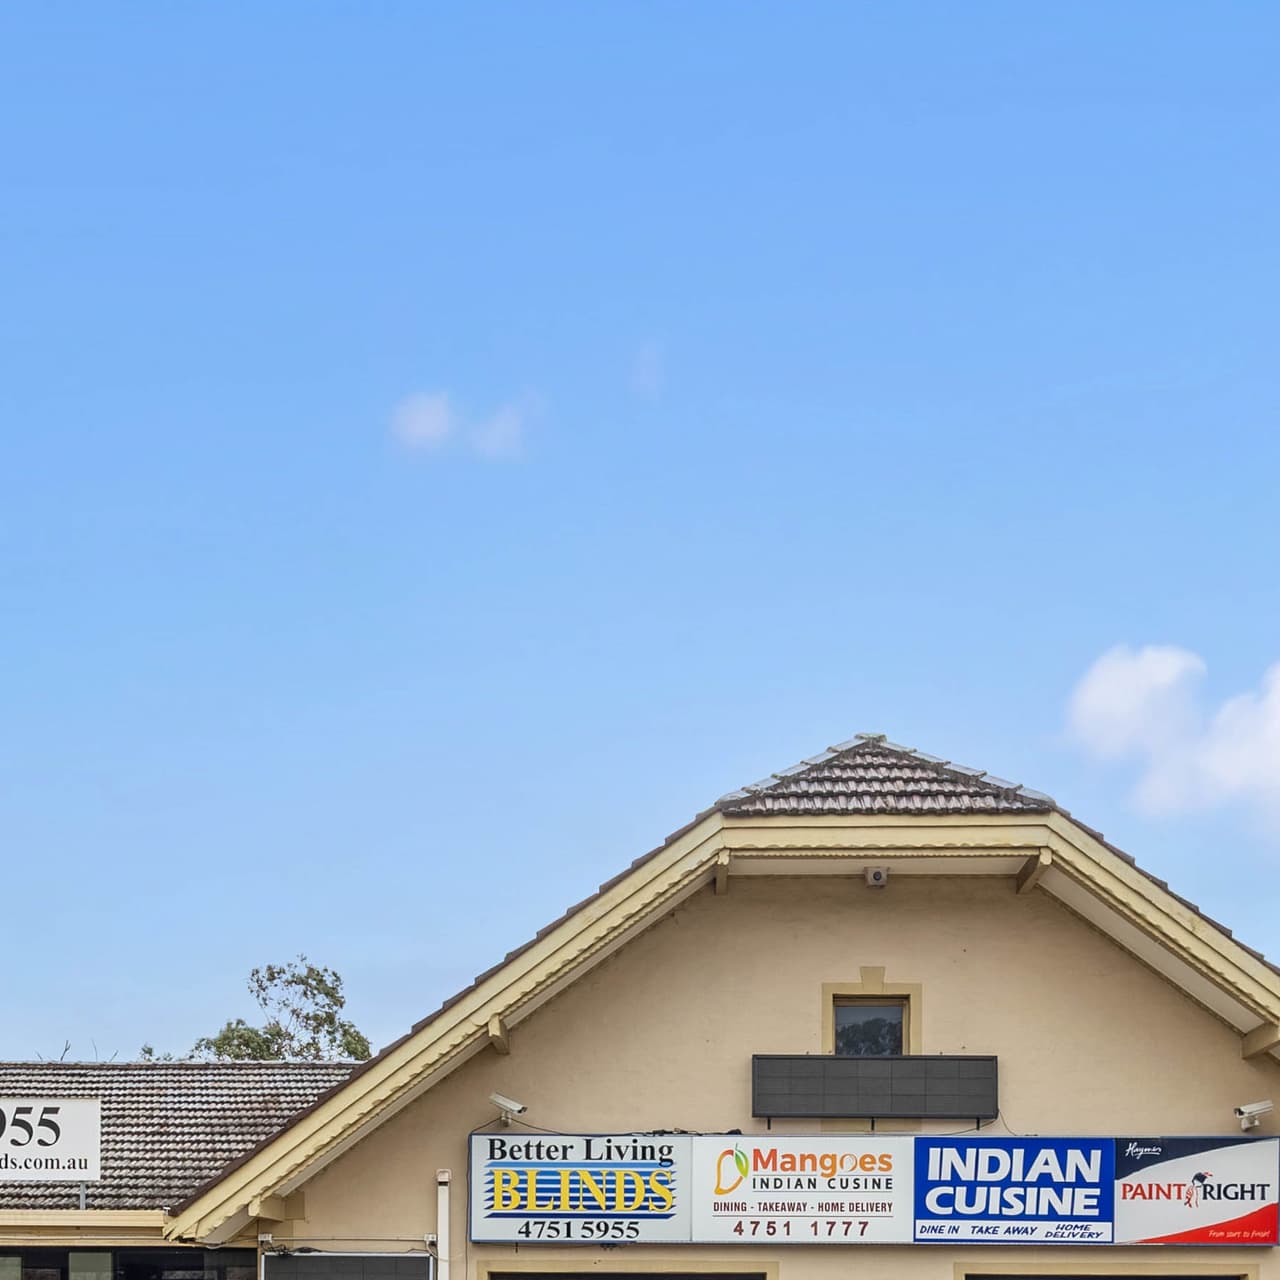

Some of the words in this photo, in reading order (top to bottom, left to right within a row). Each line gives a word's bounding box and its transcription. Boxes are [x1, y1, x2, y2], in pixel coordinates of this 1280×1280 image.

[487, 1138, 574, 1161] Better
[584, 1138, 674, 1167] Living
[753, 1148, 893, 1178] Mangoes
[926, 1147, 1101, 1182] INDIAN
[491, 1169, 674, 1213] BLINDS
[752, 1177, 817, 1190] INDIAN
[827, 1177, 893, 1190] CUSINE
[1121, 1183, 1186, 1201] PAINT
[1201, 1183, 1271, 1201] RIGHT
[713, 1202, 748, 1213] DINING
[757, 1202, 808, 1213] TAKEAWAY
[817, 1202, 846, 1213] HOME
[848, 1202, 894, 1213] DELIVERY
[924, 1186, 1100, 1216] CUISINE
[517, 1221, 573, 1239] 4751
[581, 1221, 640, 1239] 5955
[733, 1220, 792, 1236] 4751
[811, 1220, 870, 1236] 1777
[920, 1225, 946, 1234] DINE
[947, 1225, 960, 1234] IN
[970, 1225, 1000, 1235] TAKE
[1004, 1226, 1038, 1236] AWAY
[1045, 1231, 1104, 1239] DELIVERY
[1055, 1224, 1093, 1232] HOME
